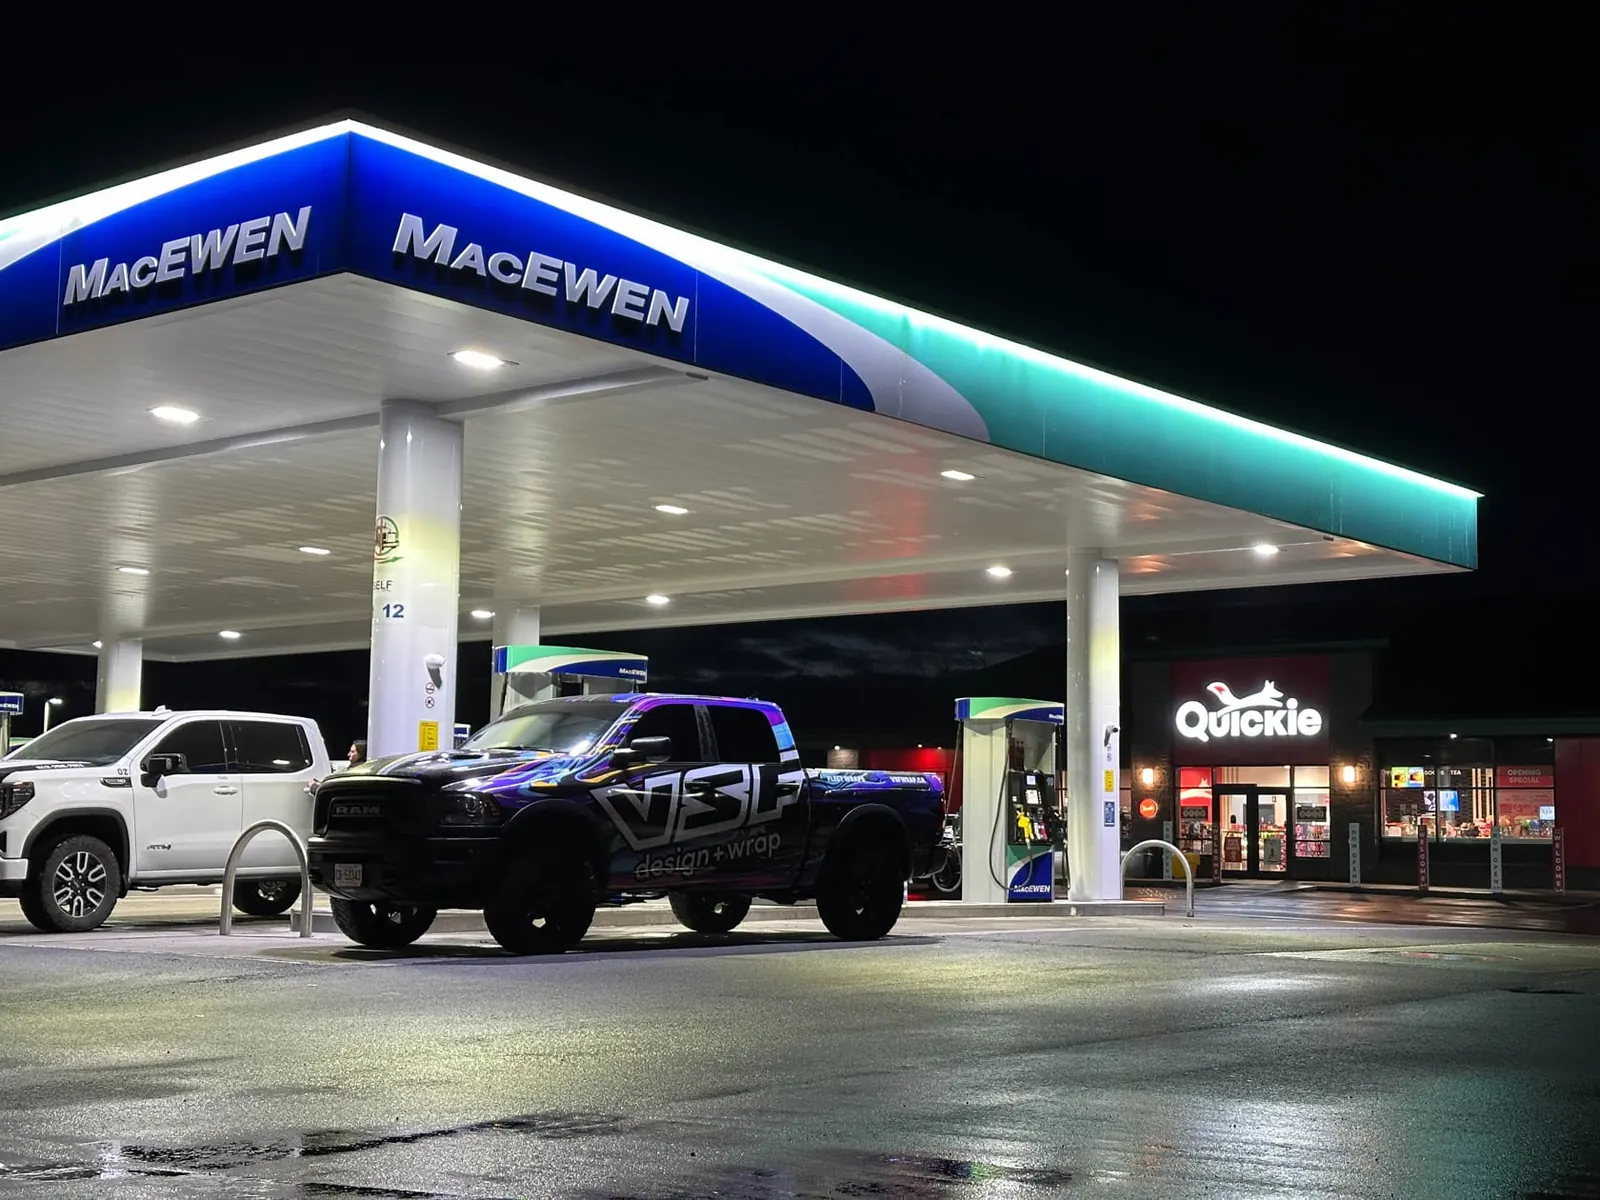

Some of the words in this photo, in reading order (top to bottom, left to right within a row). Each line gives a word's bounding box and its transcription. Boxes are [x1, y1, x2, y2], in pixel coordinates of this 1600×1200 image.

[382, 604, 404, 618] 12
[1175, 698, 1322, 742] Quickie
[335, 806, 380, 815] RAM
[1554, 835, 1562, 886] WELCOME
